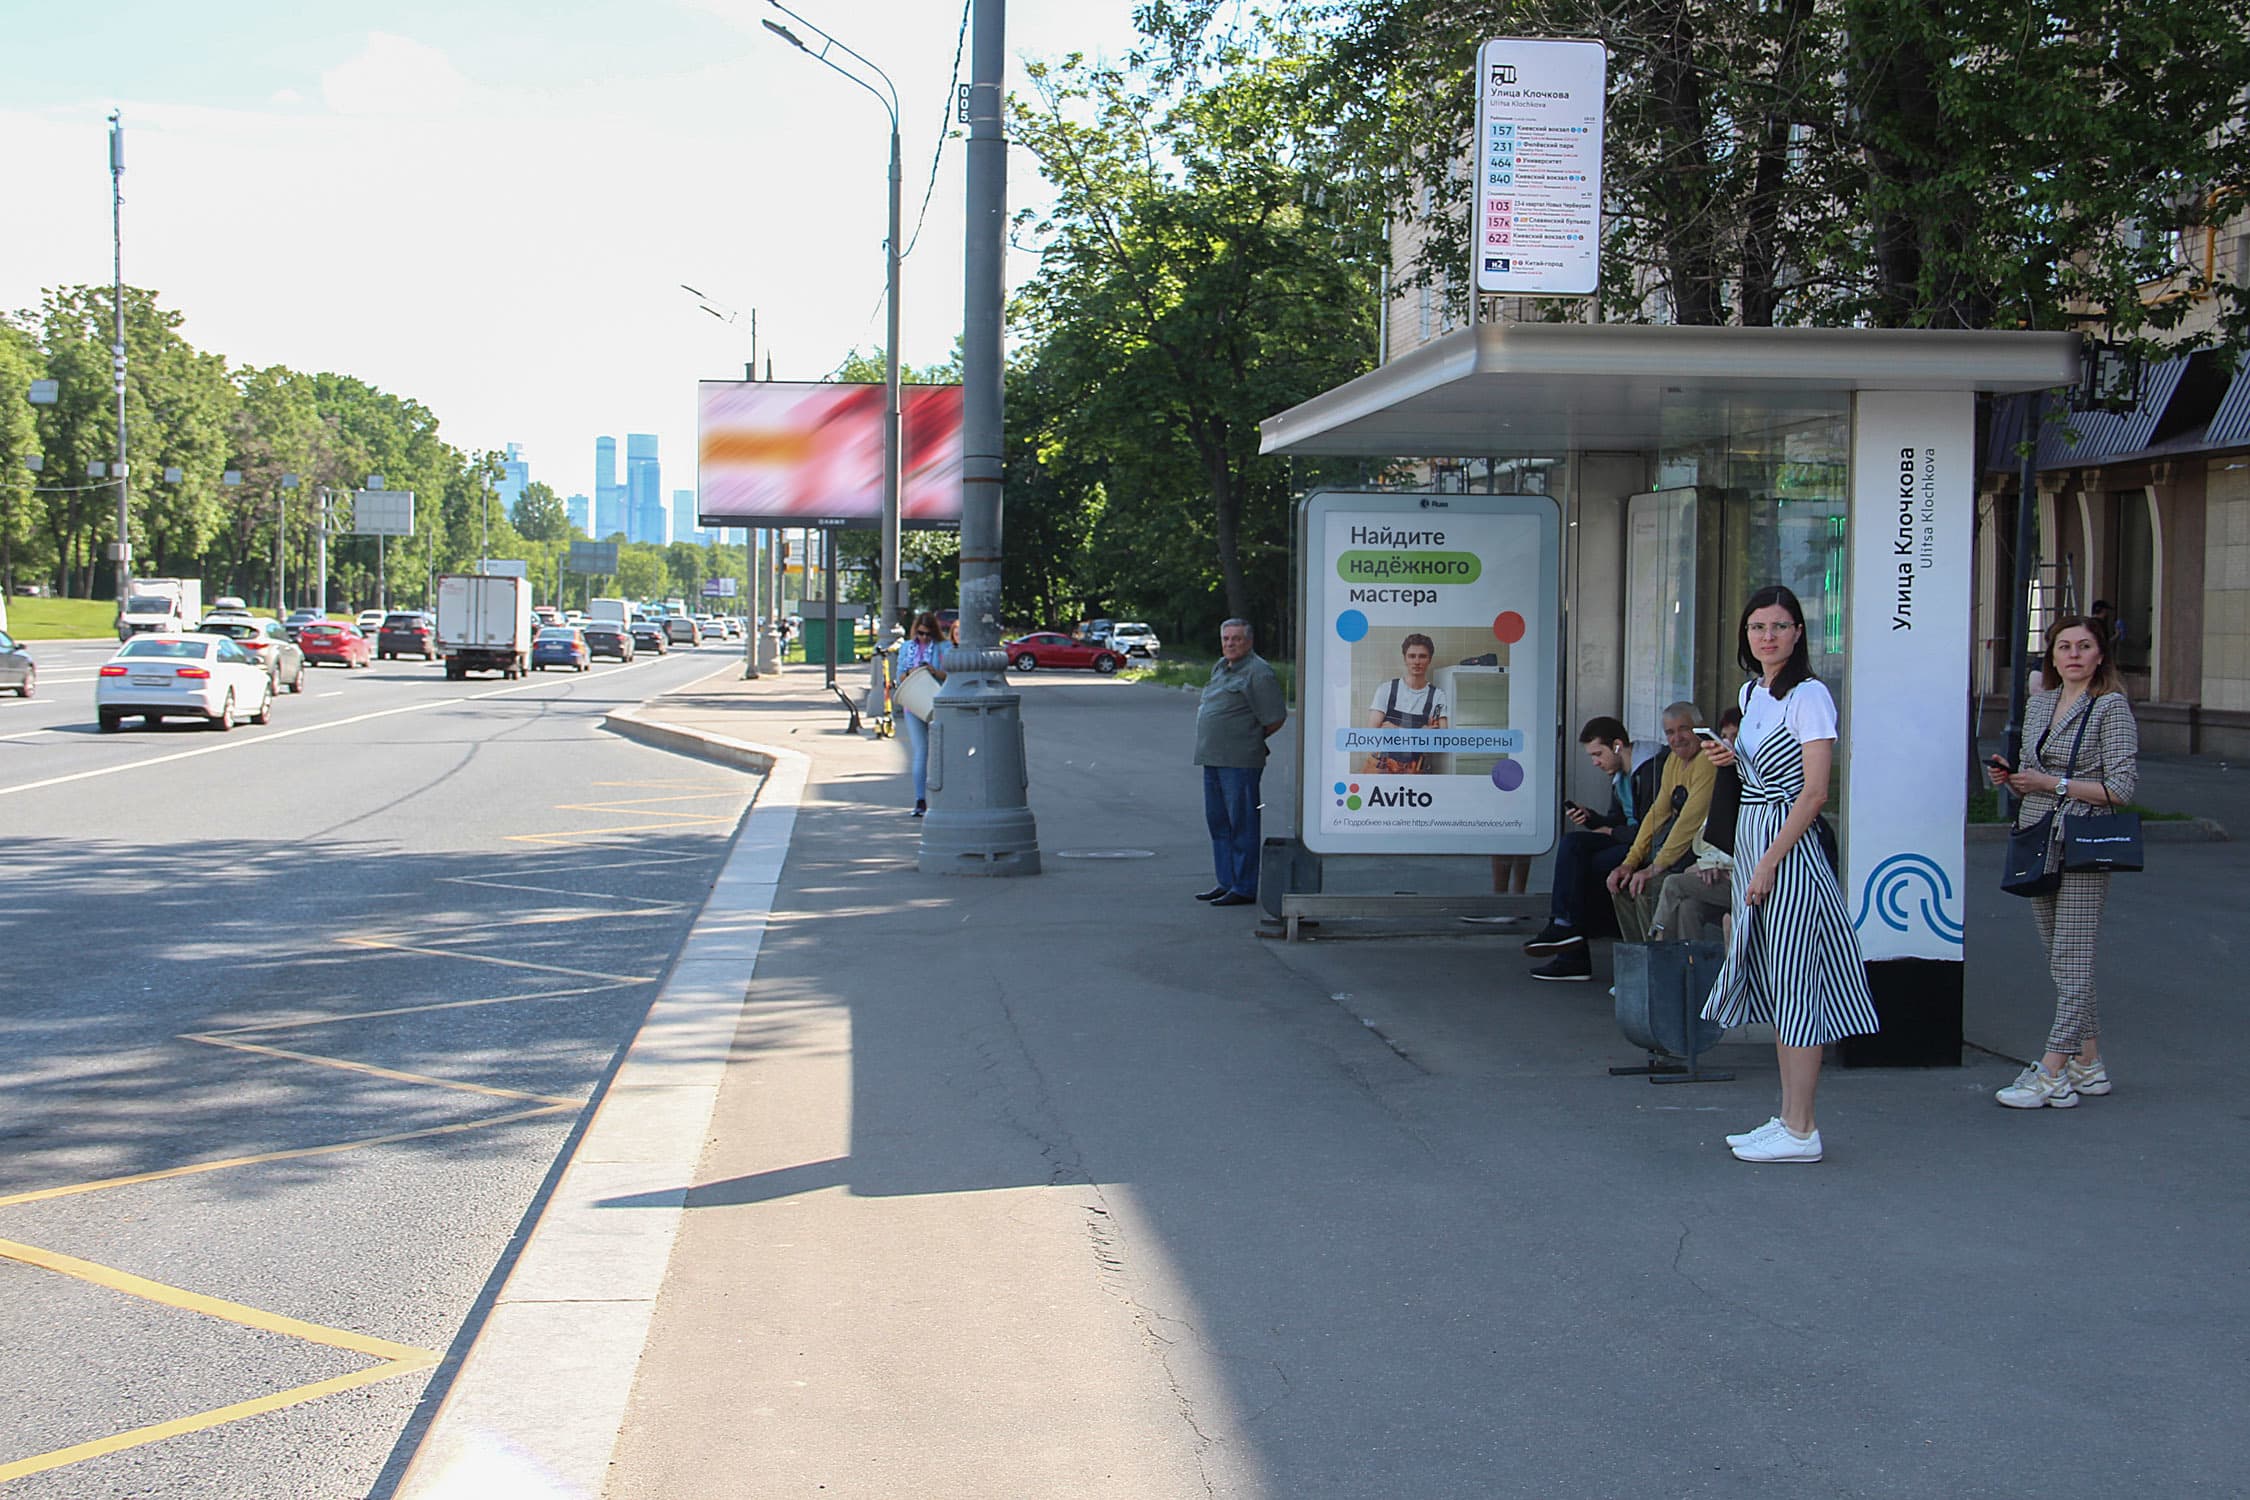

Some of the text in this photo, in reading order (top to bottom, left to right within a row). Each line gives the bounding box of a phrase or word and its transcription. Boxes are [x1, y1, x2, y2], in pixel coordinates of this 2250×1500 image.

[1490, 88, 1570, 99] Улица Клочкова
[1511, 100, 1546, 108] Klochkova
[1492, 125, 1513, 136] 157
[1492, 142, 1512, 152] 231
[1490, 158, 1511, 168] 464
[1489, 174, 1511, 184] 840
[1490, 201, 1510, 211] 103
[1488, 233, 1509, 243] 622
[1920, 448, 1935, 569] Ulitsa Klochkova
[1351, 526, 1446, 549] Найдите
[1892, 447, 1915, 631] Улица Клочкова
[1350, 556, 1470, 577] надёжного
[1350, 588, 1438, 606] мастера
[1345, 732, 1513, 749] Документы проверены
[1367, 785, 1433, 808] Avito
